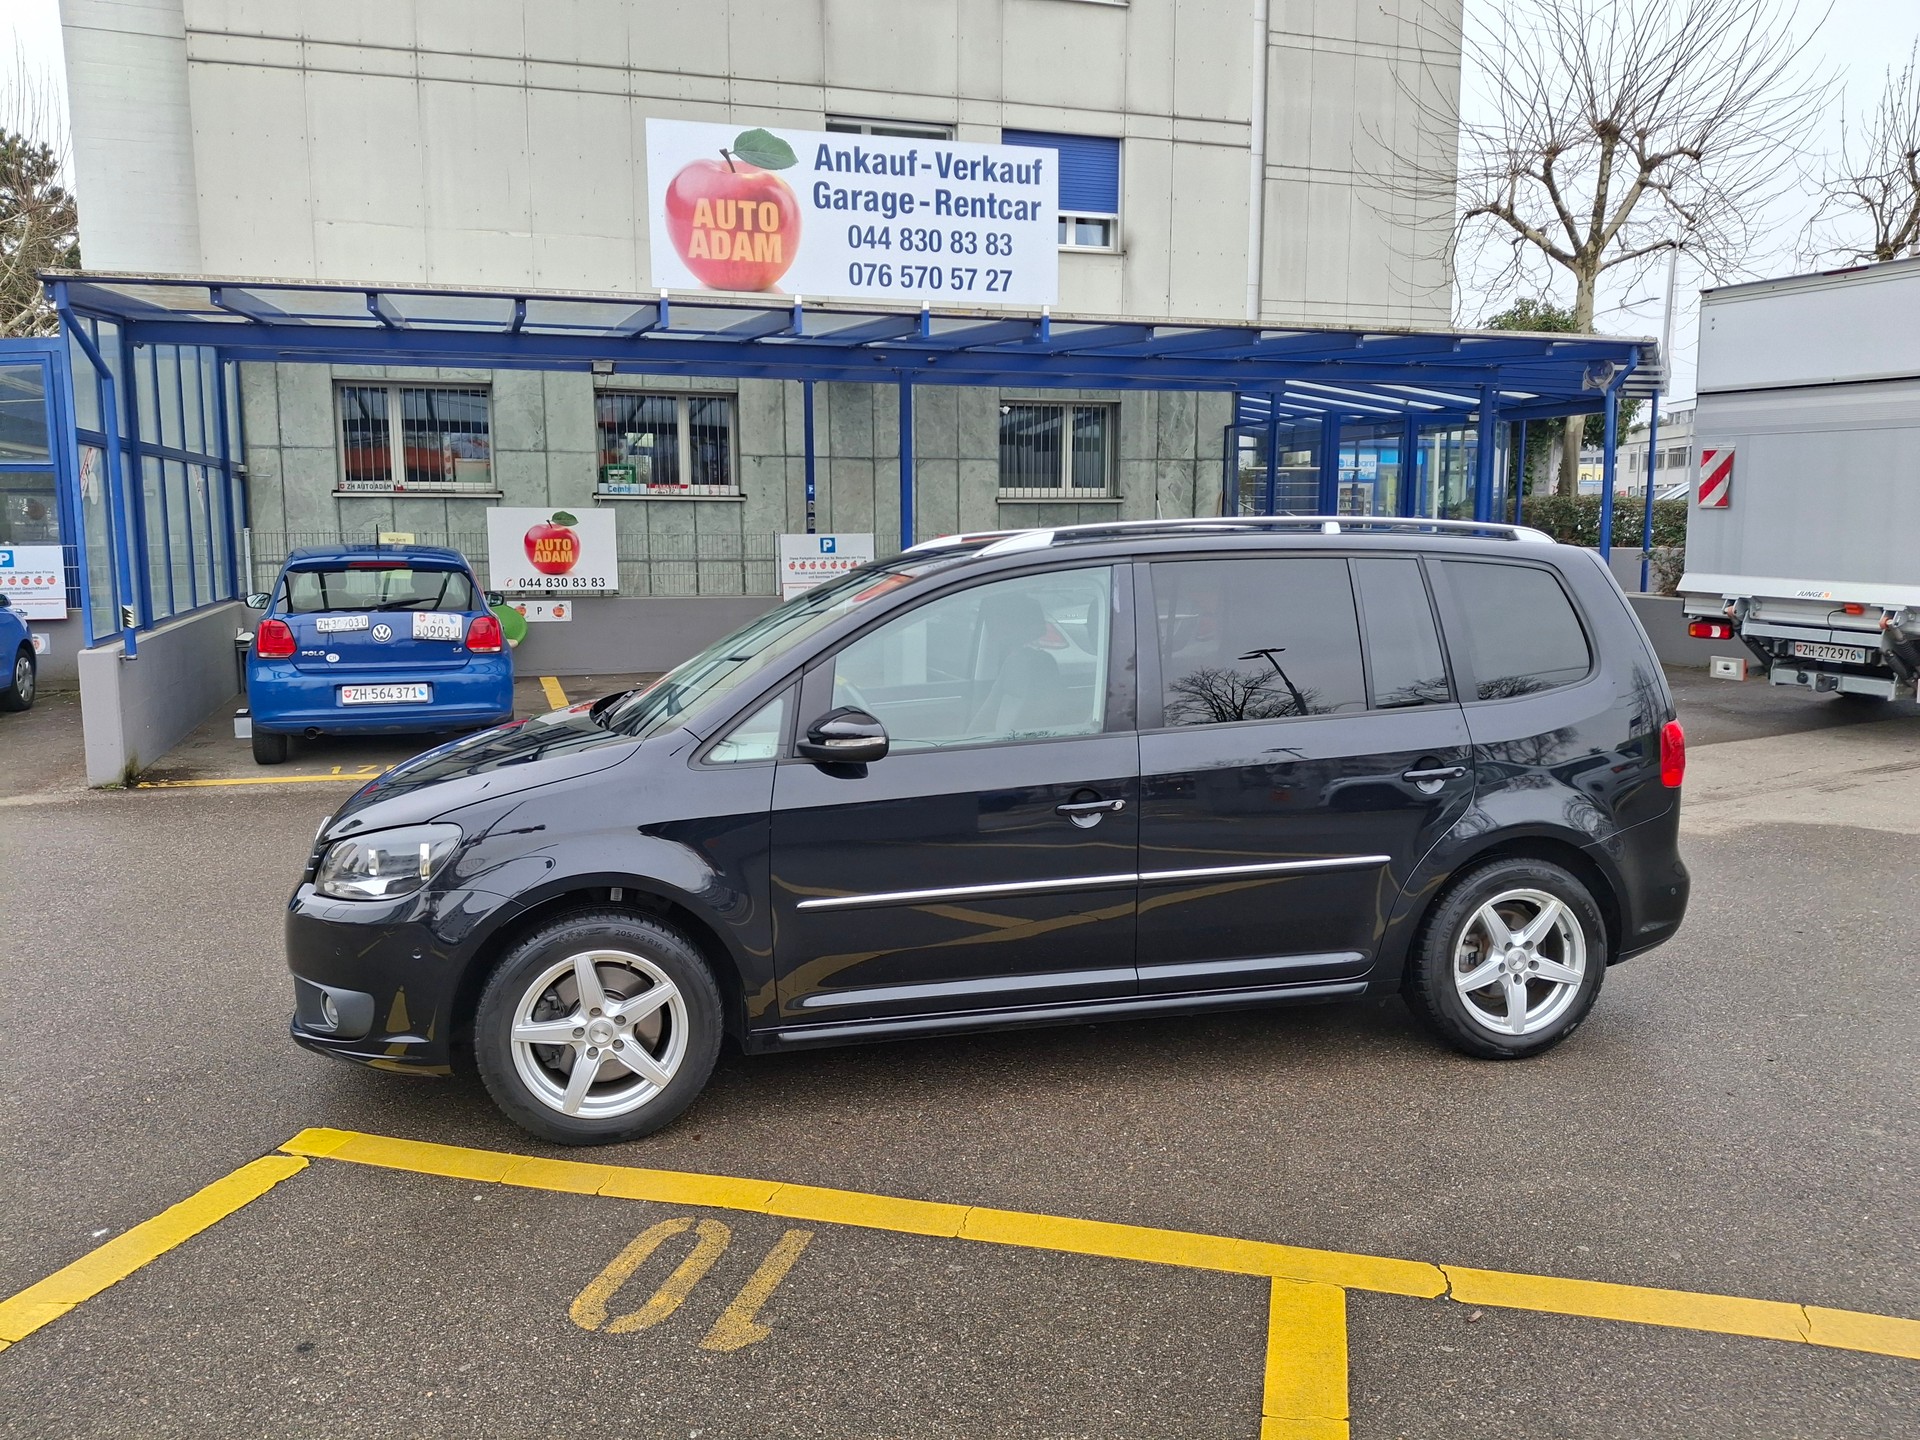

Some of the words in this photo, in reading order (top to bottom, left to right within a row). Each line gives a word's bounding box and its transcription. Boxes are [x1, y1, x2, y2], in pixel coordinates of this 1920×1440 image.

[814, 143, 1043, 186] Ankauf-Verkauf
[692, 197, 780, 233] AUTO
[813, 180, 1042, 222] Garage-Rentcar
[688, 230, 783, 264] ADAM
[848, 225, 892, 250] 044
[900, 228, 943, 252] 830
[950, 230, 978, 255] 83
[985, 232, 1013, 257] 83
[848, 262, 893, 288] 076
[900, 264, 943, 290] 570
[950, 267, 978, 292] 57
[985, 269, 1013, 293] 27
[533, 550, 573, 563] ADAM
[535, 538, 572, 551] AUTO
[519, 578, 542, 588] 044
[546, 578, 568, 588] 830
[572, 578, 587, 588] 83
[591, 578, 606, 588] 83
[536, 606, 542, 615] P
[615, 930, 645, 941] 205/55
